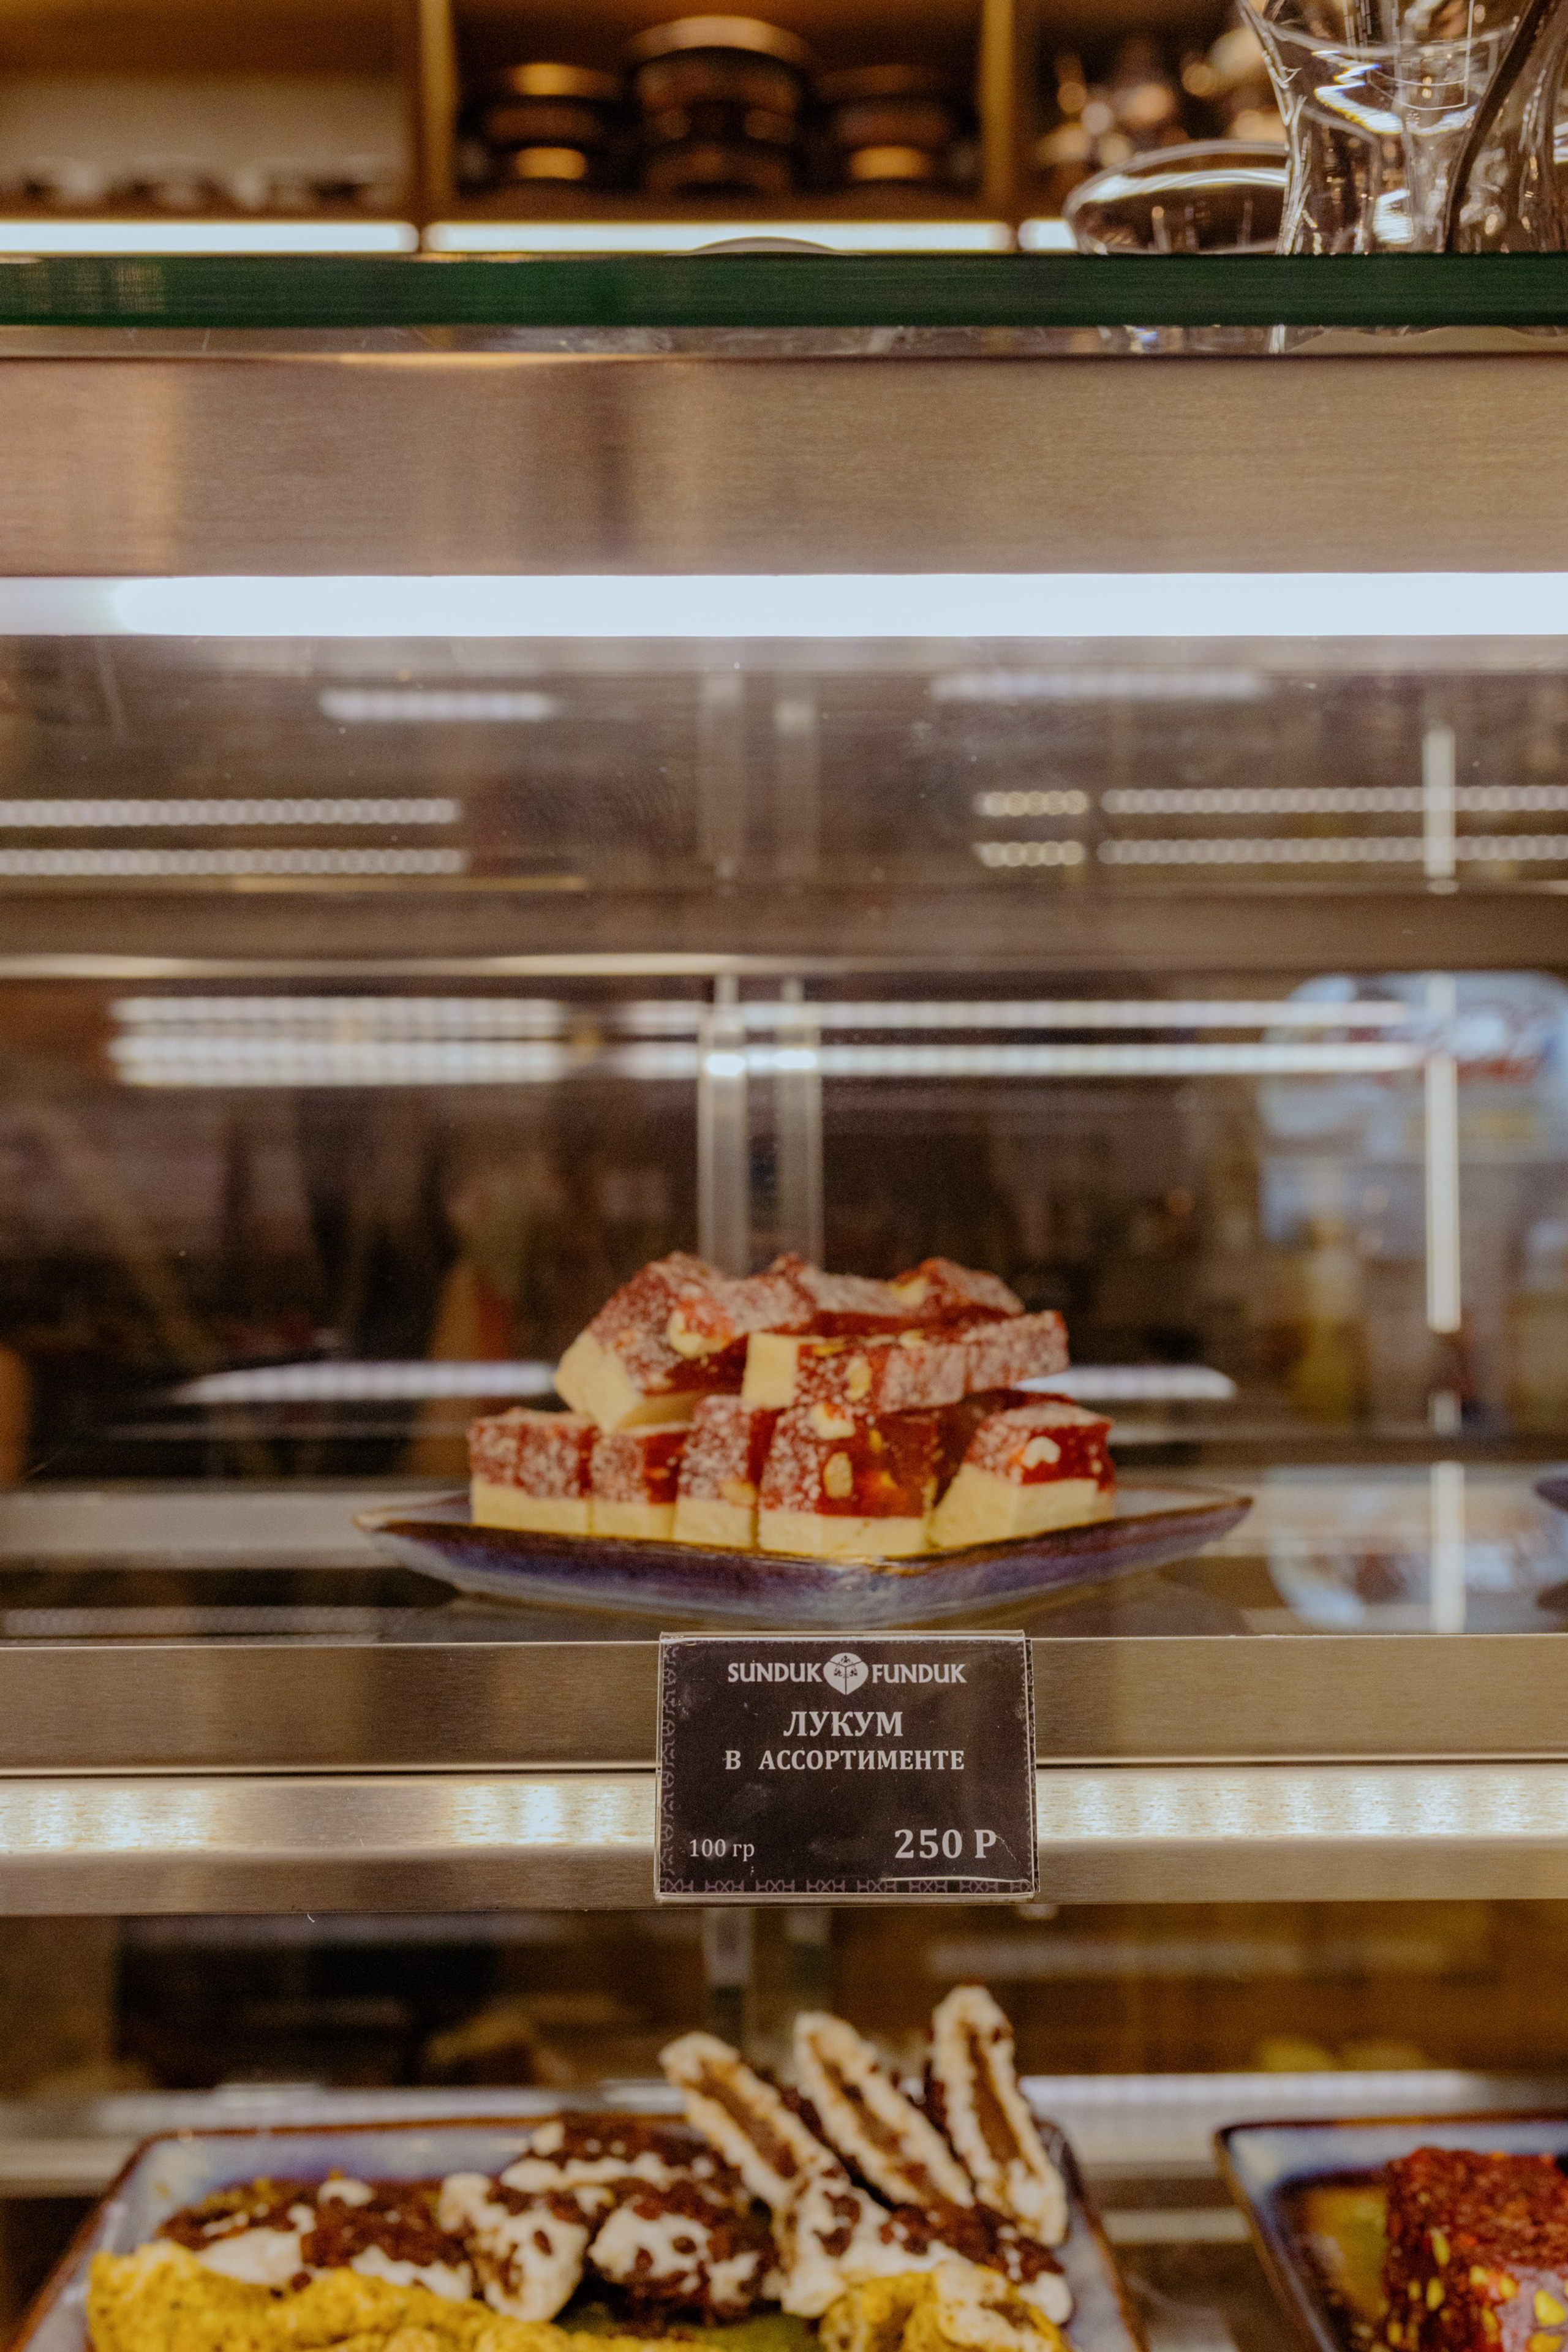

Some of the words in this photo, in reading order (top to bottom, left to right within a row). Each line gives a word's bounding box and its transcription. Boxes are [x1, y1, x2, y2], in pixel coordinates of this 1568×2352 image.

[728, 1662, 823, 1683] SUNDUK
[872, 1663, 967, 1684] FUNDUK
[783, 1711, 903, 1737] ЛУКУМ
[725, 1750, 741, 1770] В
[758, 1749, 965, 1770] АССОРТИМЕНТЕ
[689, 1839, 726, 1858] 100
[733, 1842, 755, 1862] гр
[894, 1828, 963, 1860] 250
